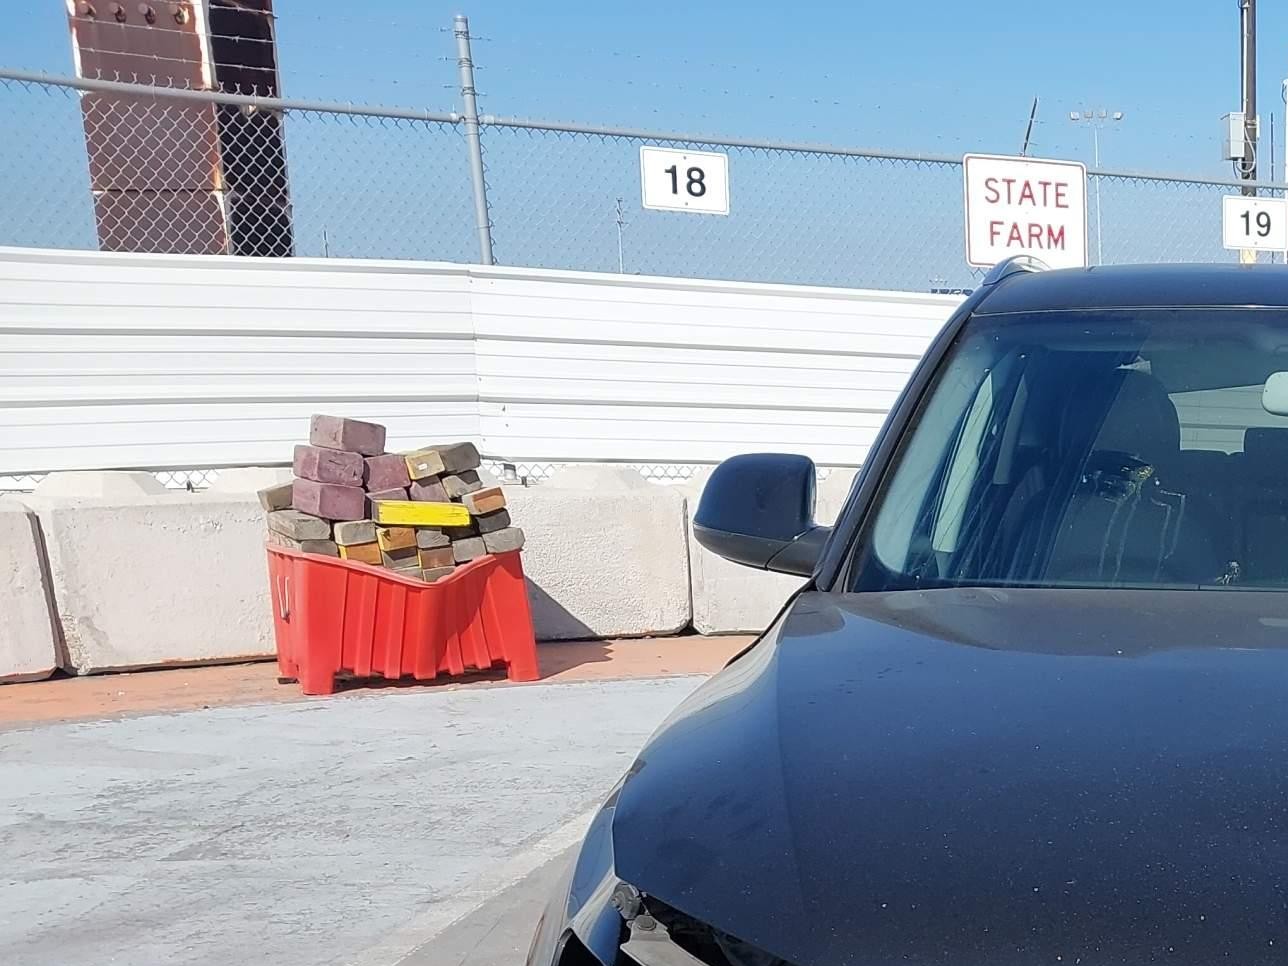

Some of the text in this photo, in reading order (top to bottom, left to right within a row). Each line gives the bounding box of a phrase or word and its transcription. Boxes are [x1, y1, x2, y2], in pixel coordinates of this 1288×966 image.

[664, 164, 707, 198] 18
[984, 177, 1069, 209] STATE
[989, 220, 1065, 251] FARM
[1240, 210, 1272, 238] 19
